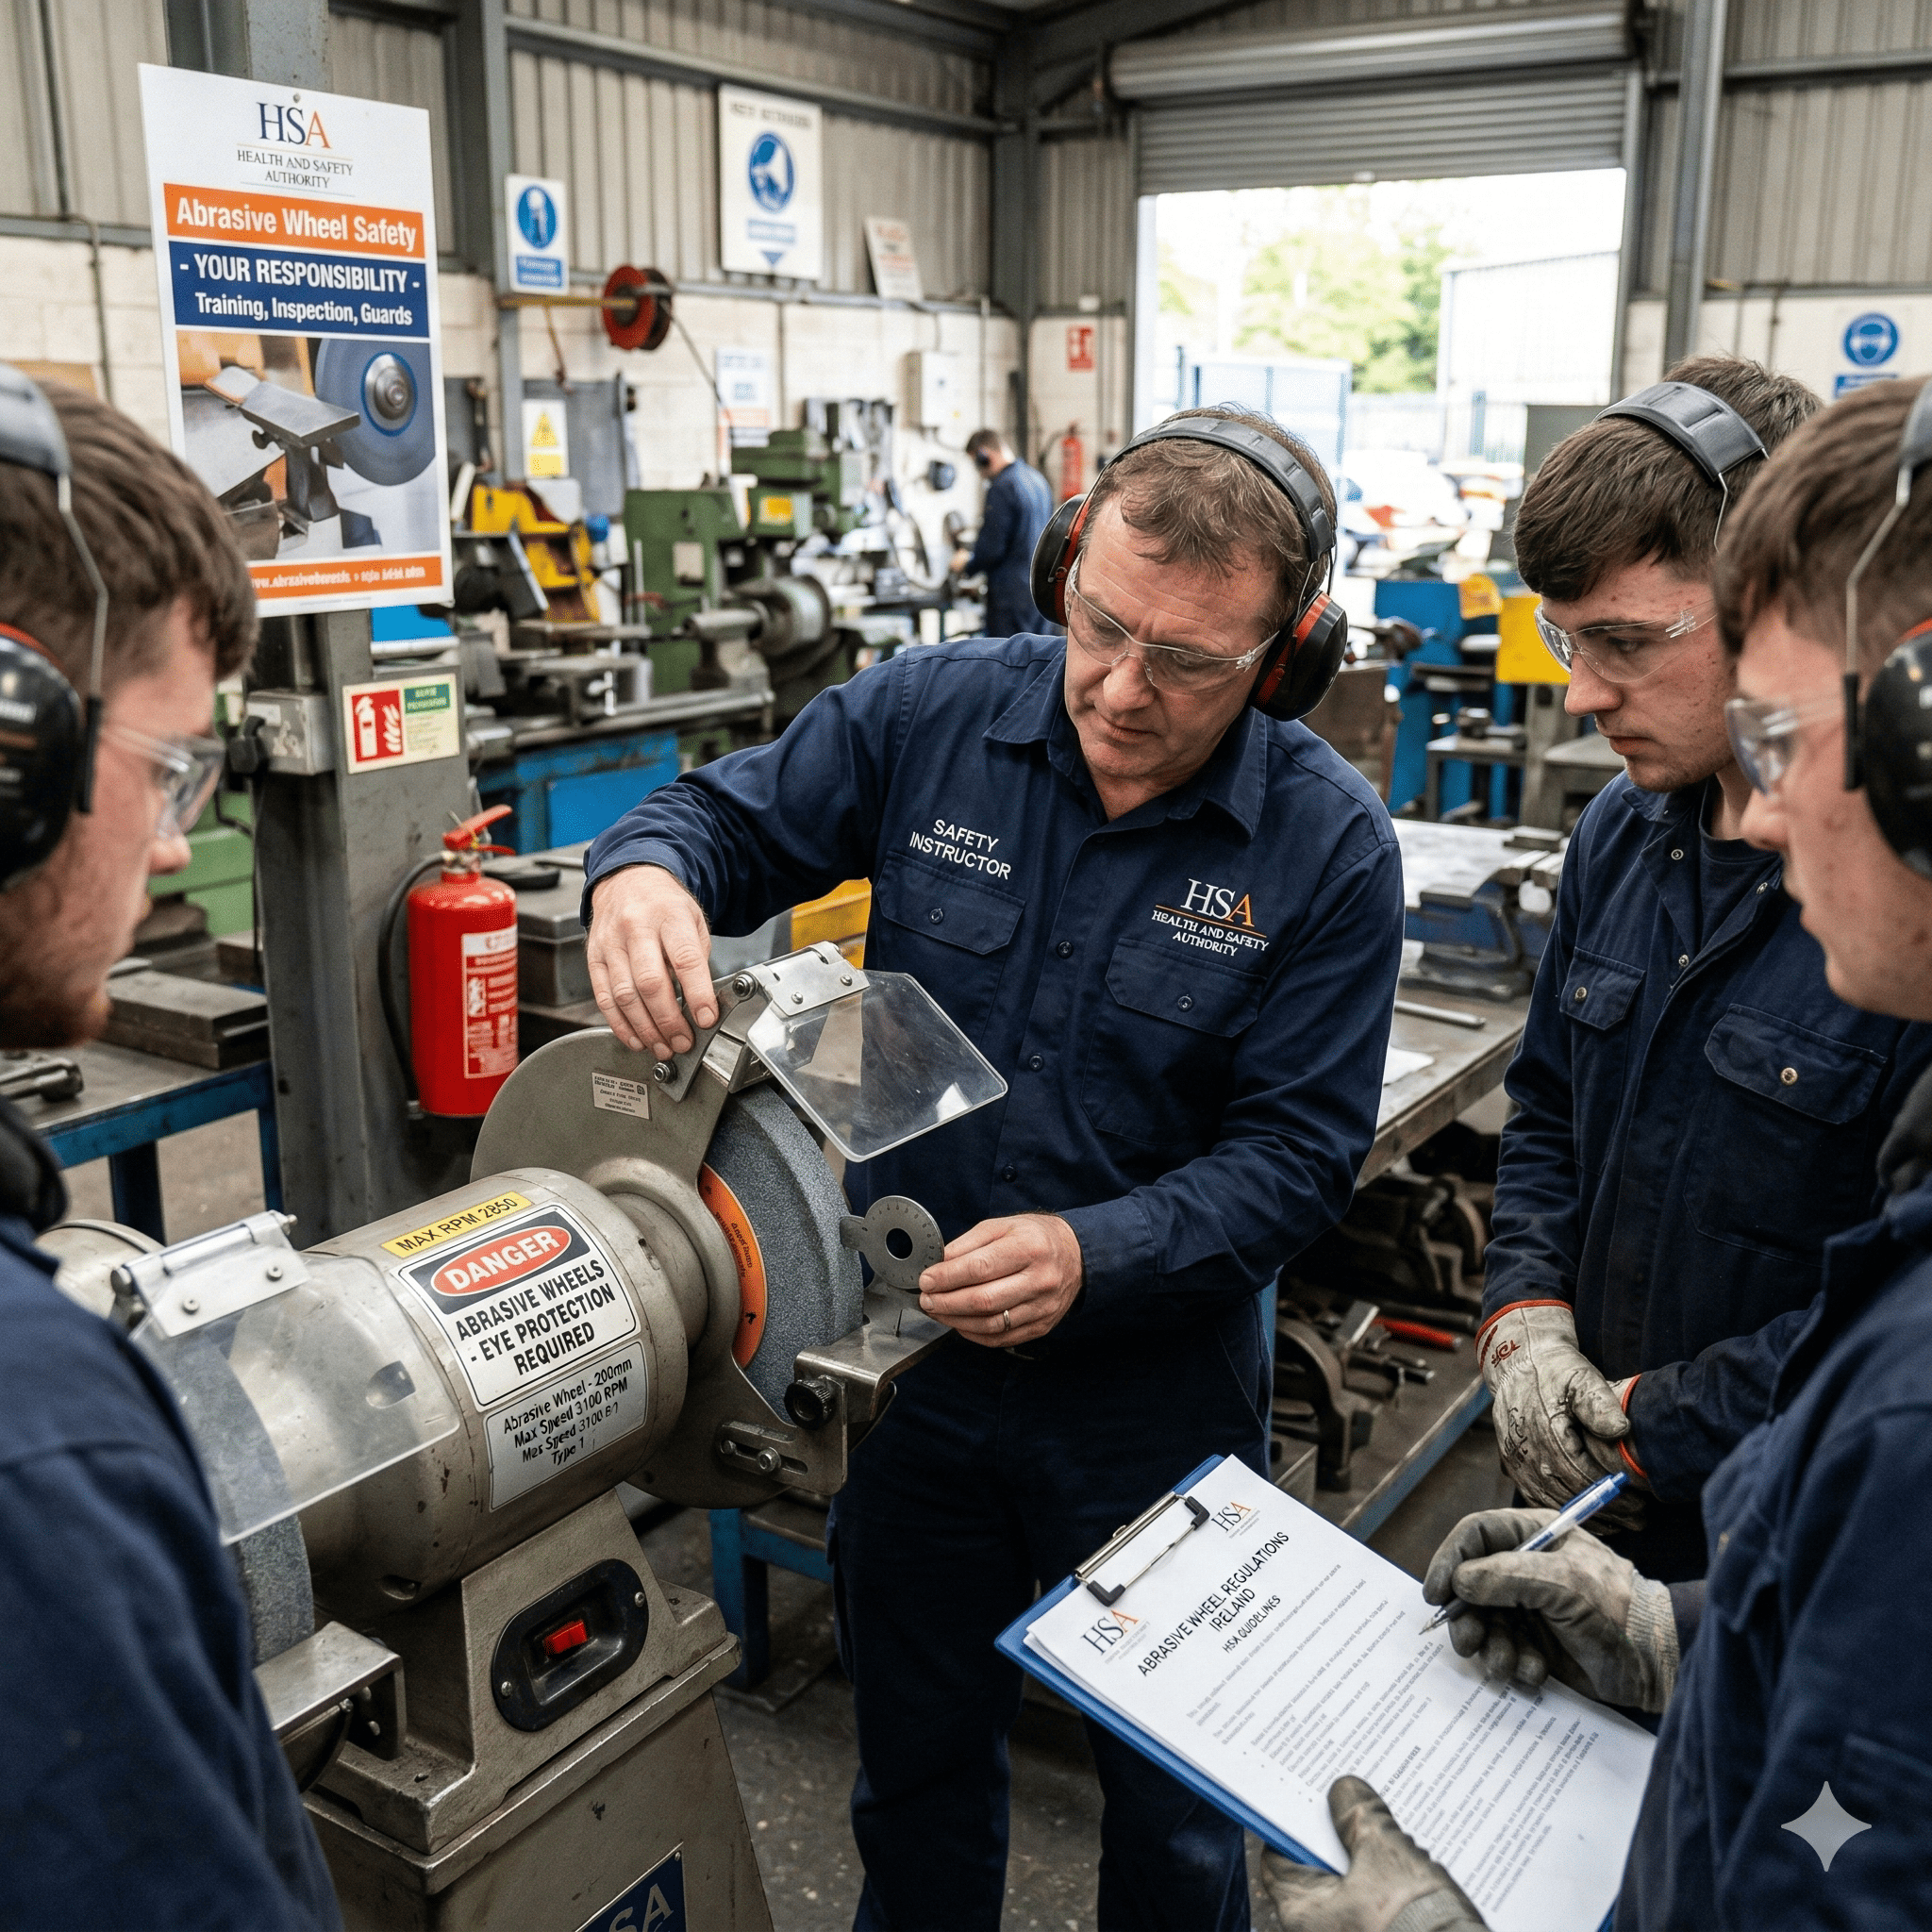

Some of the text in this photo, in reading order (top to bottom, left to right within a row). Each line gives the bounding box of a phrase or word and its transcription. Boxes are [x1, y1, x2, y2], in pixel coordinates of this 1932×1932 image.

[256, 102, 331, 148] HSA
[237, 150, 353, 175] HEALTH AND SAFETY
[265, 170, 329, 189] AUTHORITY
[176, 197, 417, 253] Abrasive Wheel Safety
[193, 253, 251, 281] YOUR
[256, 258, 407, 292] RESPONSIBILITY
[195, 291, 413, 325] Training, Inspection, Guards
[909, 830, 1011, 880] INSTRUCTOR
[933, 819, 998, 853] SAFETY
[1180, 878, 1255, 927] HSA
[1151, 909, 1270, 952] HEALTH AND SAFETY
[1173, 931, 1238, 957] AUTHORITY
[395, 1198, 518, 1252] MAX RPM 2850
[443, 1229, 561, 1291] DANGER
[455, 1259, 605, 1341] ABRASIVE WHEELS
[478, 1329, 516, 1361] EYE
[518, 1283, 616, 1342] PROTECTION
[513, 1321, 595, 1376] REQUIRED
[504, 1402, 551, 1434] Abrasive
[594, 1358, 633, 1387] 200mm
[514, 1427, 538, 1448] Max
[575, 1391, 603, 1416] 3100
[604, 1376, 628, 1401] RPM
[578, 1409, 604, 1433] 3100
[1211, 1501, 1252, 1533] HSA
[1137, 1623, 1193, 1677] ABRASIVE
[1185, 1592, 1227, 1630] WHEEL
[1221, 1531, 1290, 1597] REGULATIONS
[1208, 1588, 1256, 1632] IRELAND
[1079, 1608, 1139, 1656] HSA
